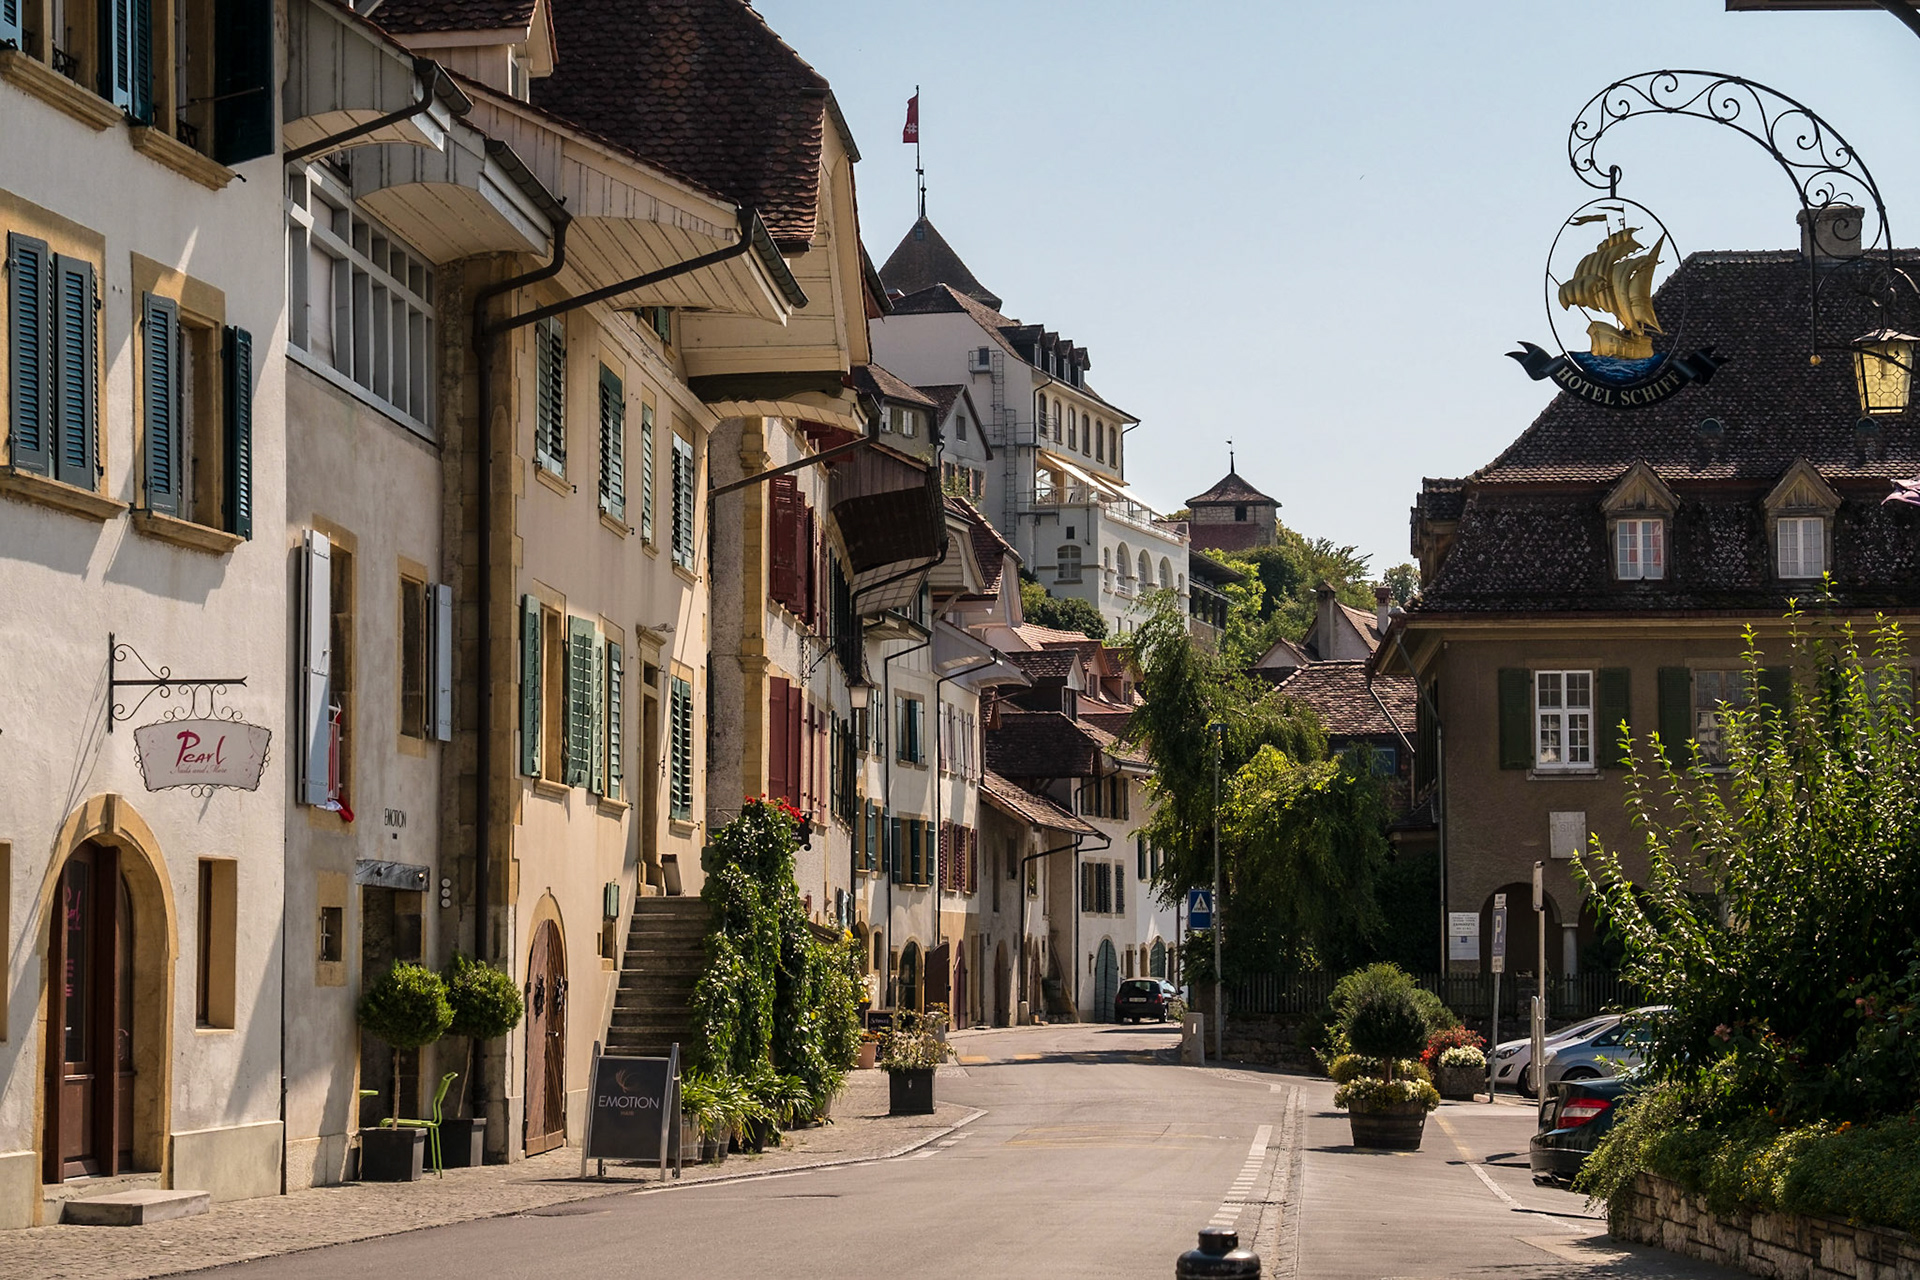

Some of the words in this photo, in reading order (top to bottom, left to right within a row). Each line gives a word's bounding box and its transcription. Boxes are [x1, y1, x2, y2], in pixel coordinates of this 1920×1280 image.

[1556, 366, 1615, 405] HOTEL
[1620, 370, 1681, 405] SCHIFF
[176, 729, 227, 767] Pearl
[385, 808, 406, 829] EMOTION
[599, 1095, 659, 1109] EMOTION
